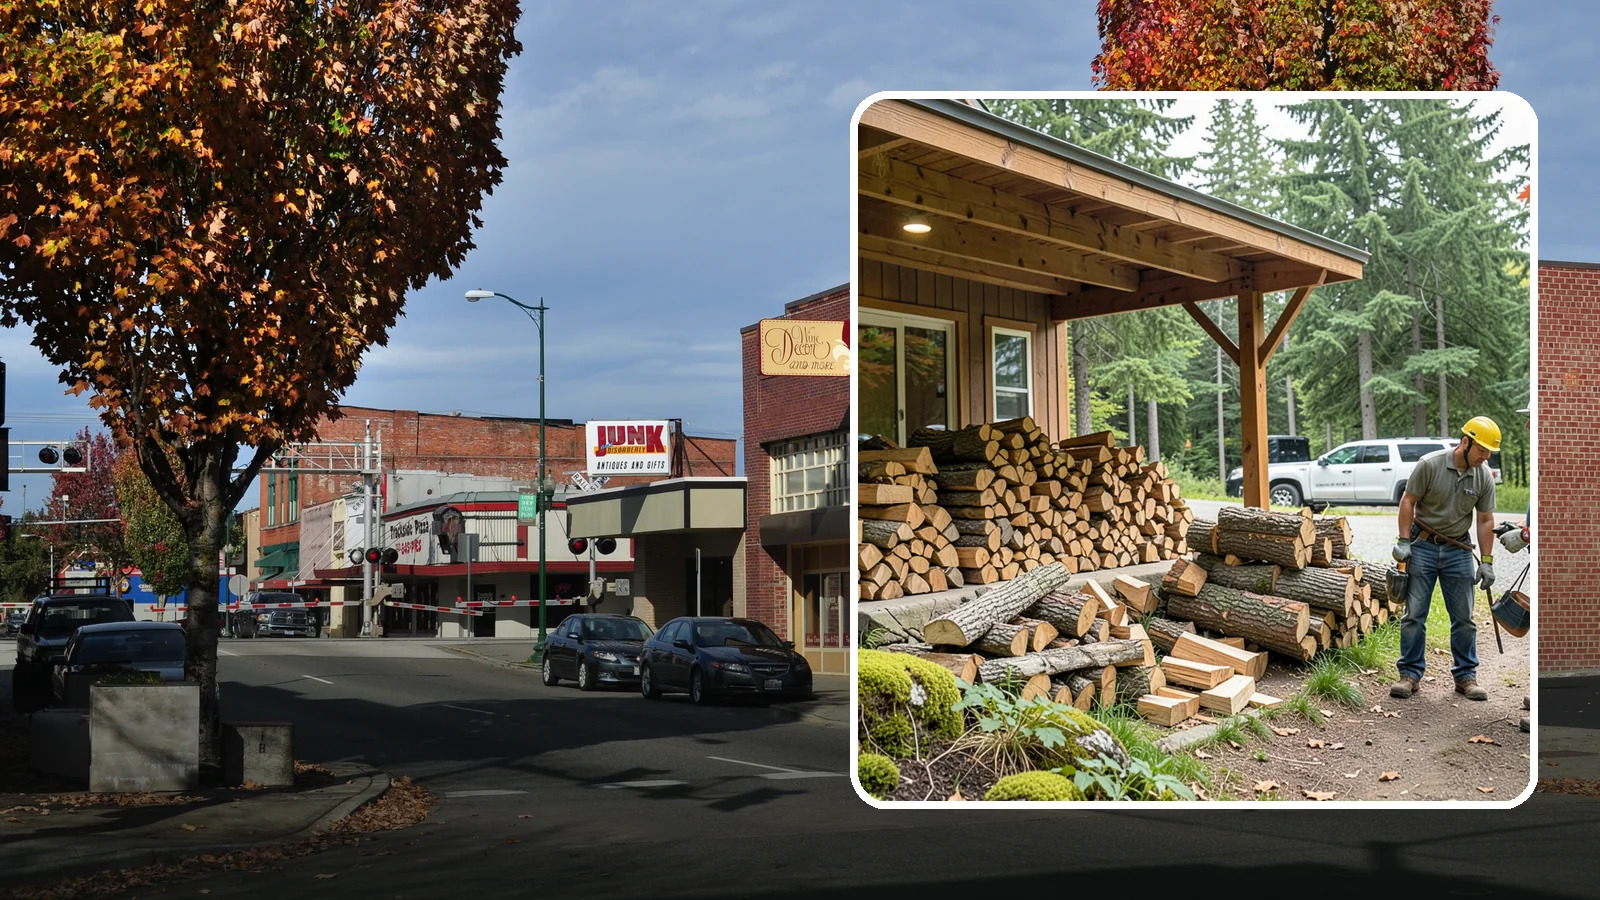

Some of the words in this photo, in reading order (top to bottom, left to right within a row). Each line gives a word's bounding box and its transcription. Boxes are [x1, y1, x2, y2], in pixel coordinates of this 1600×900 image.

[595, 425, 665, 457] JUNK
[607, 446, 646, 454] DISORDERLY
[597, 461, 628, 470] ANTIQUES
[631, 461, 644, 469] AND
[647, 461, 665, 469] GIFTS
[390, 521, 413, 540] Trackside
[415, 520, 429, 535] Pizza
